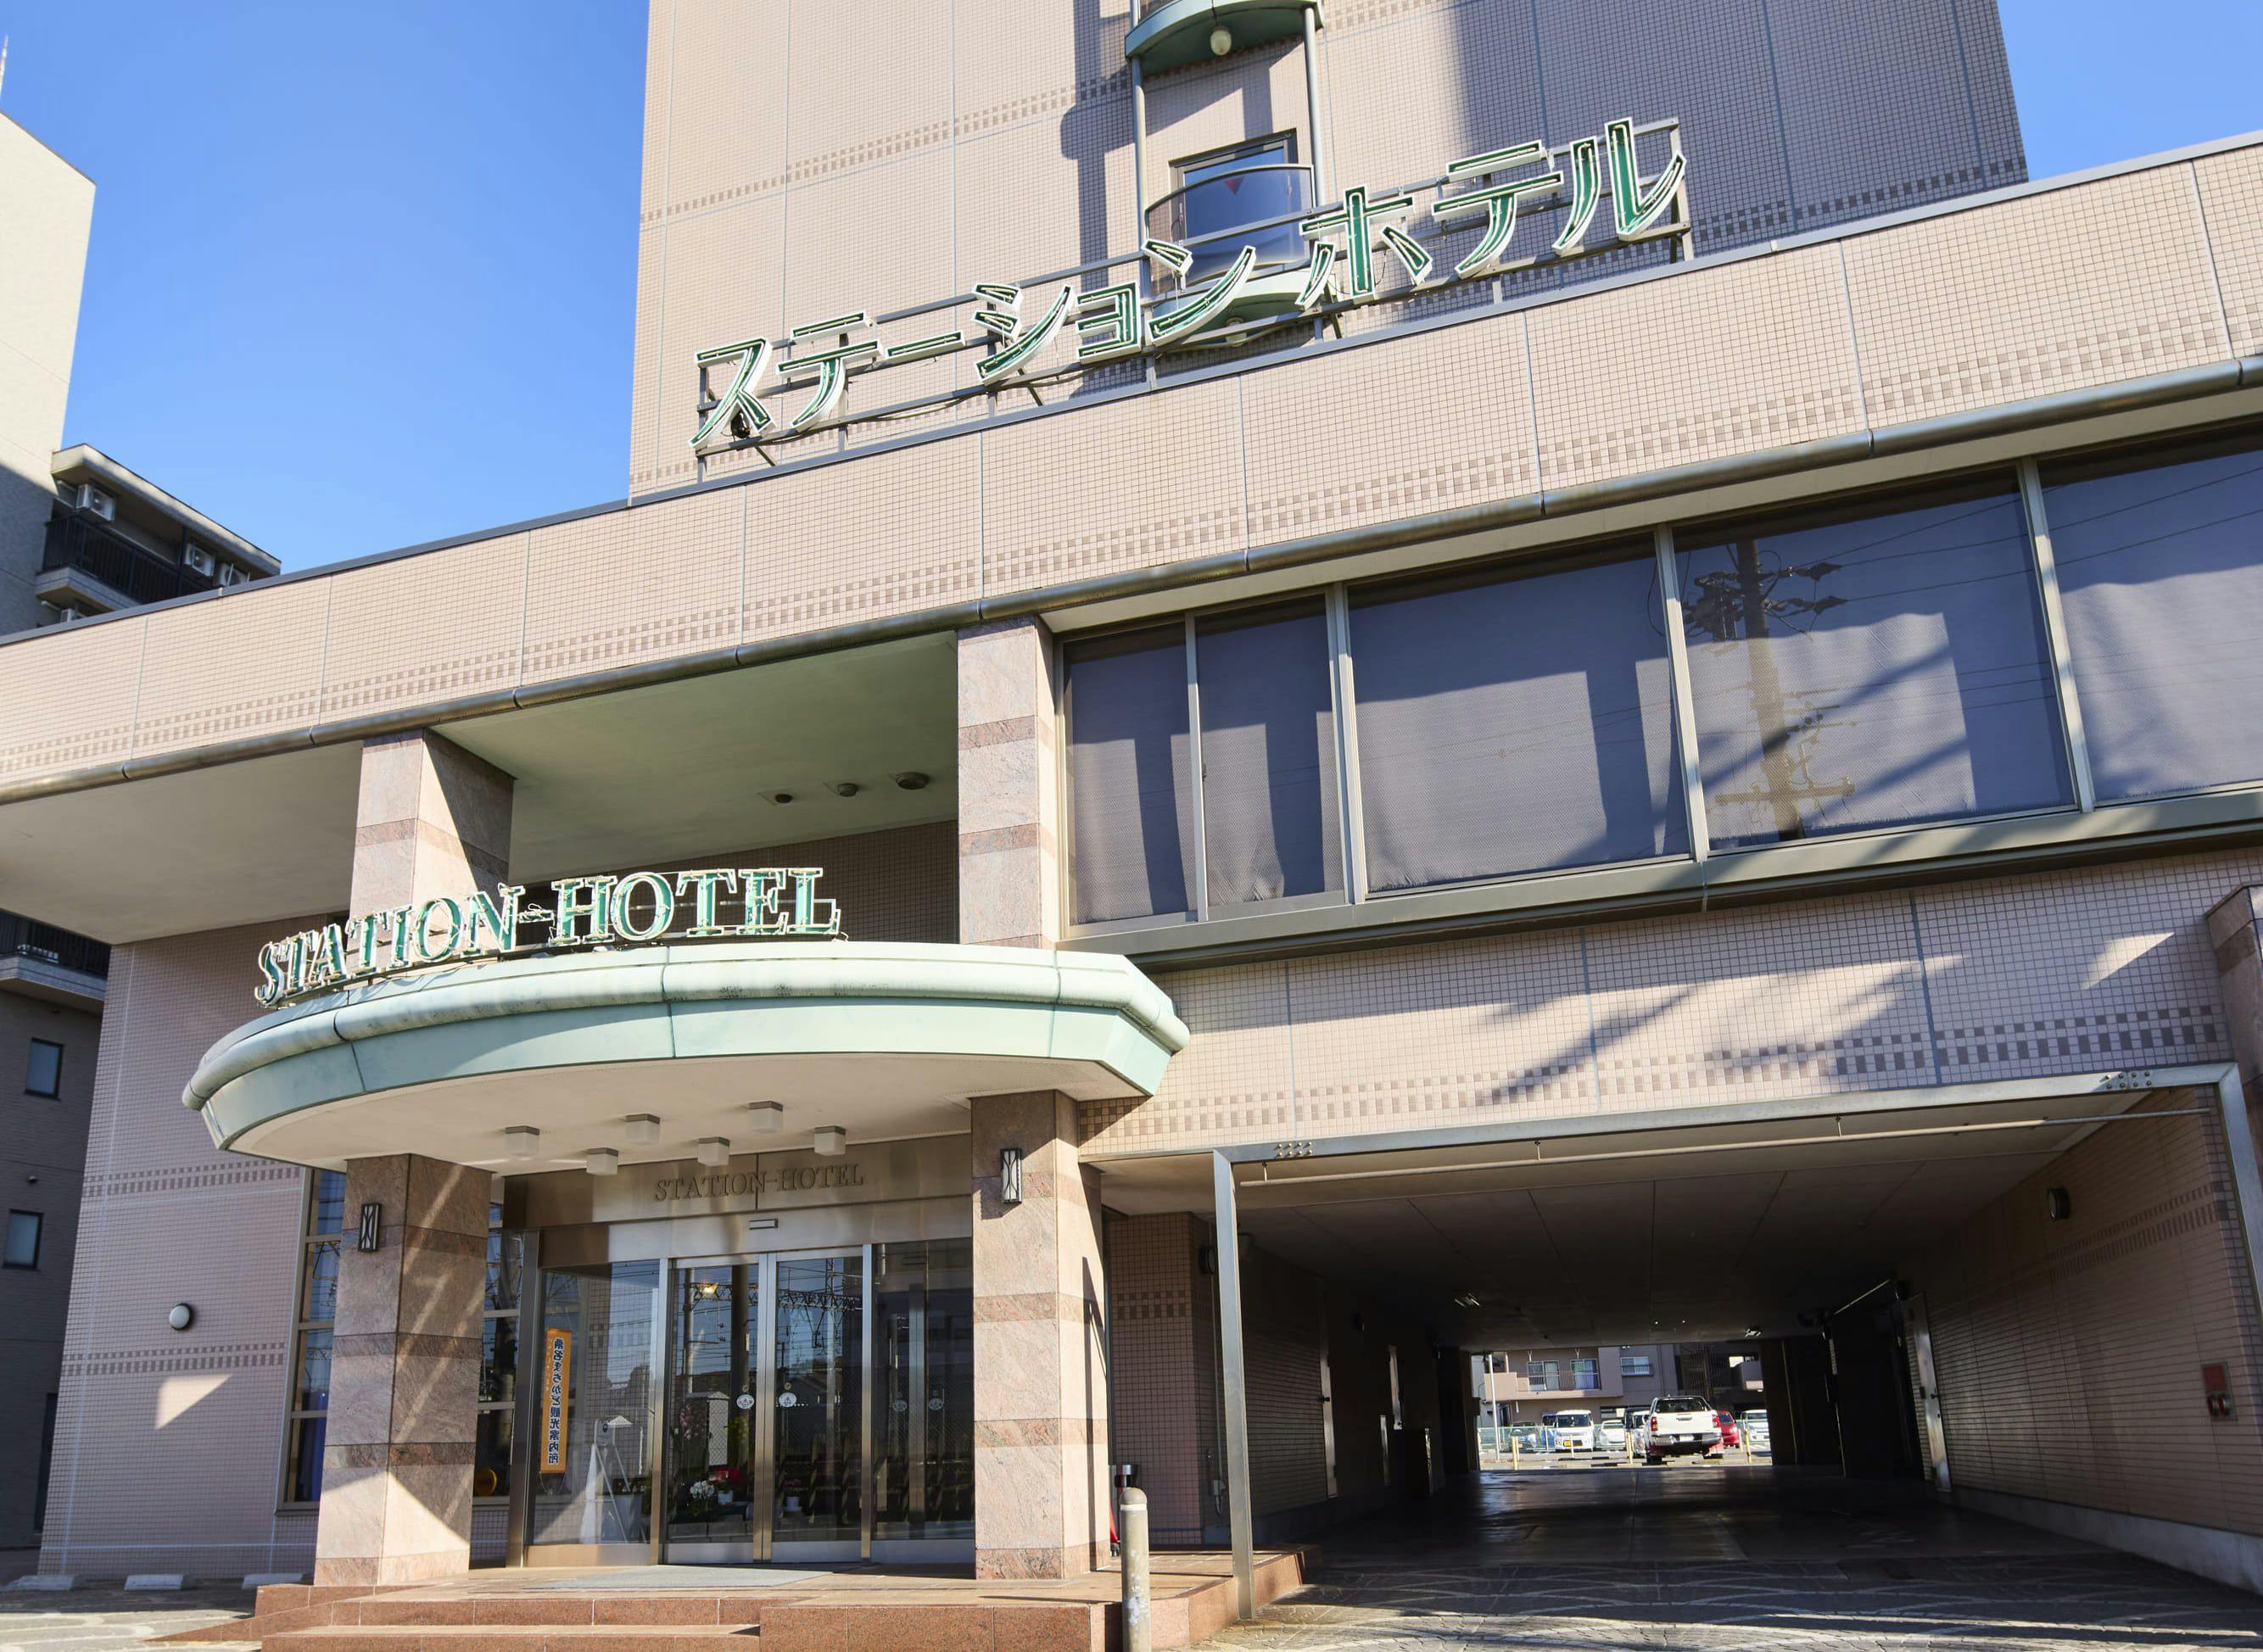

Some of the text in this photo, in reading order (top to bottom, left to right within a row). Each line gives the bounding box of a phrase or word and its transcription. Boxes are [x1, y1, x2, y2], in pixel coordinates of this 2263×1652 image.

[690, 117, 1686, 448] ステーションホテル
[254, 867, 841, 1007] STATION-HOTEL
[654, 1164, 863, 1202] STATION-HOTEL
